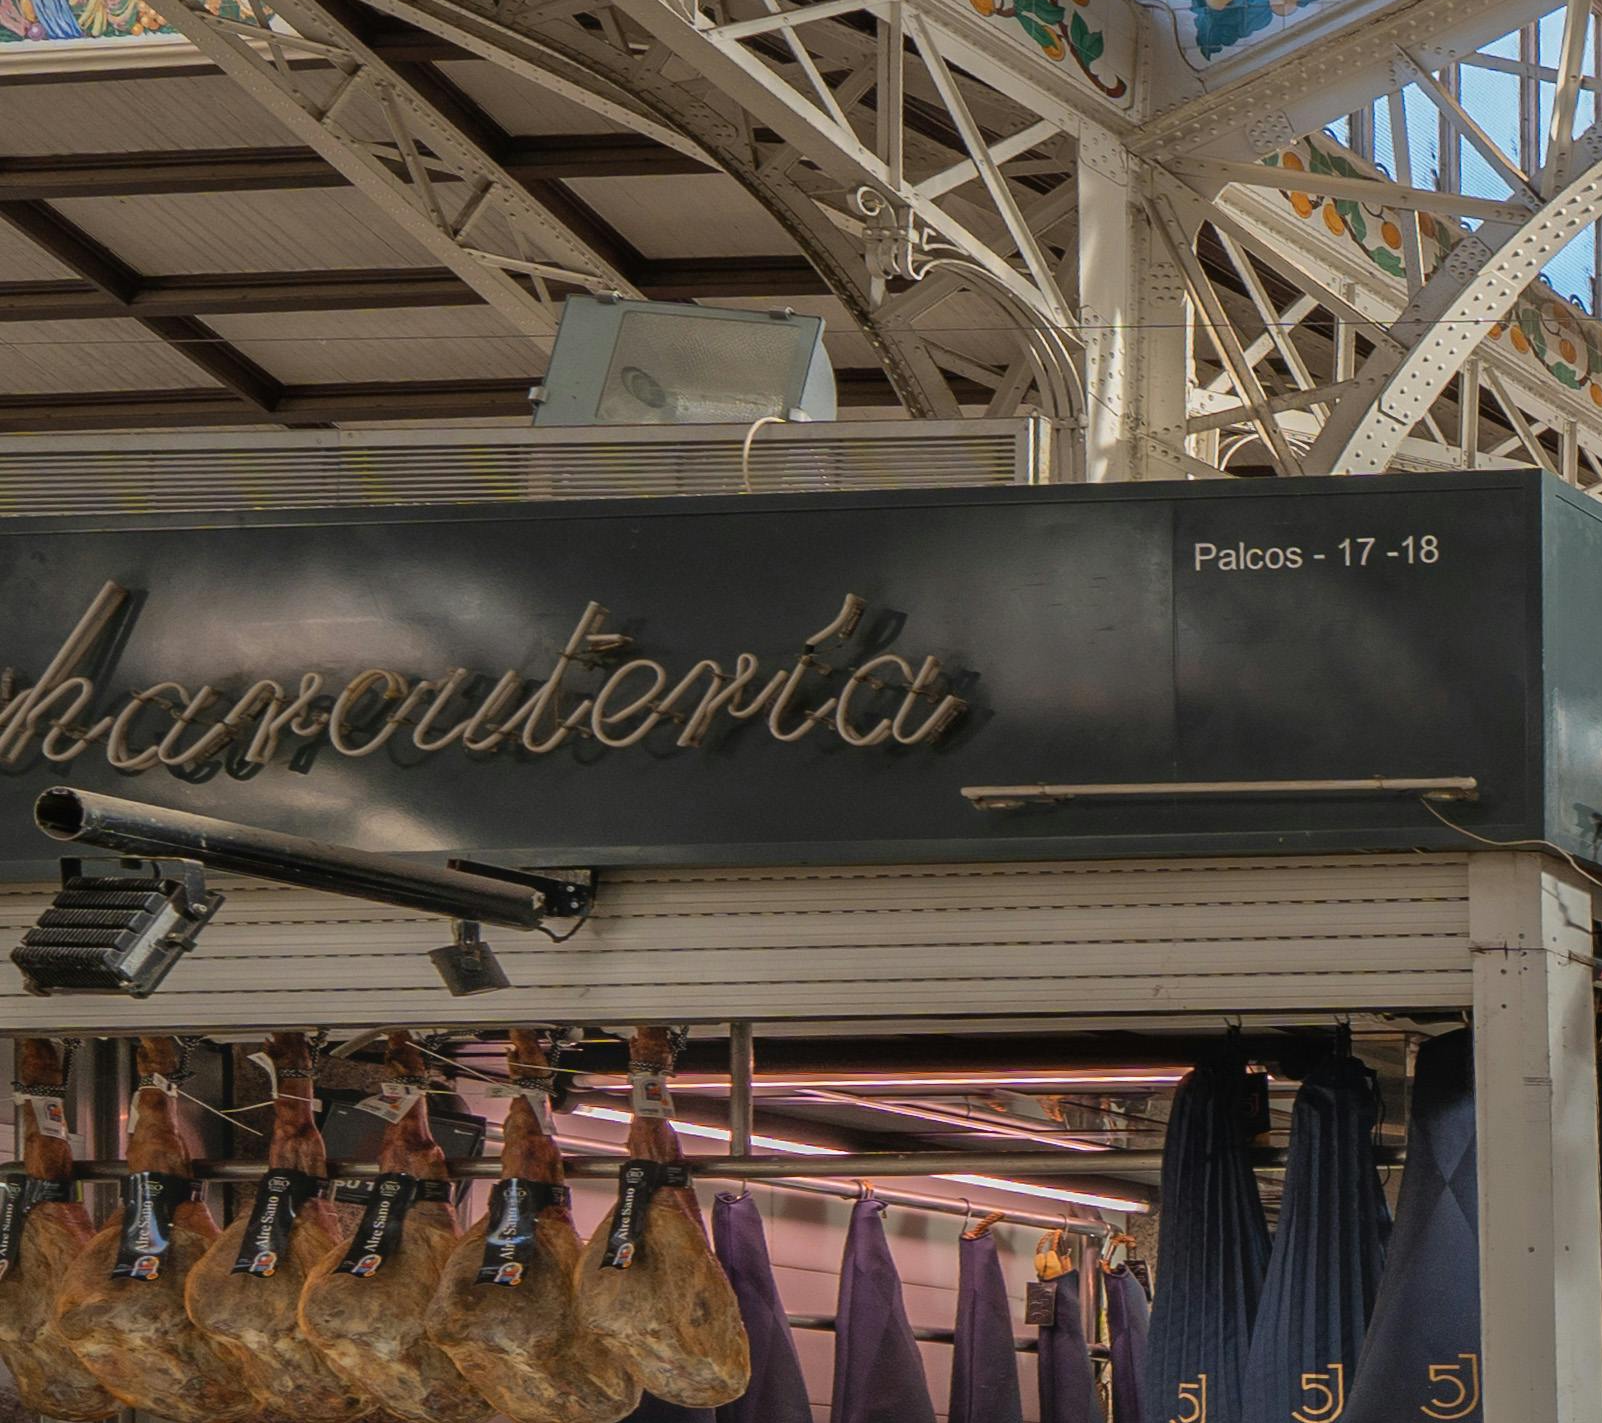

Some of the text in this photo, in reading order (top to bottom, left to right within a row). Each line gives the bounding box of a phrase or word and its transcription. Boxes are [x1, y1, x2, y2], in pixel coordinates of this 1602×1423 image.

[1194, 539, 1304, 572] Palcos
[1338, 537, 1376, 569] 17
[0, 579, 968, 769] harcutería
[1420, 1353, 1480, 1421] 5J
